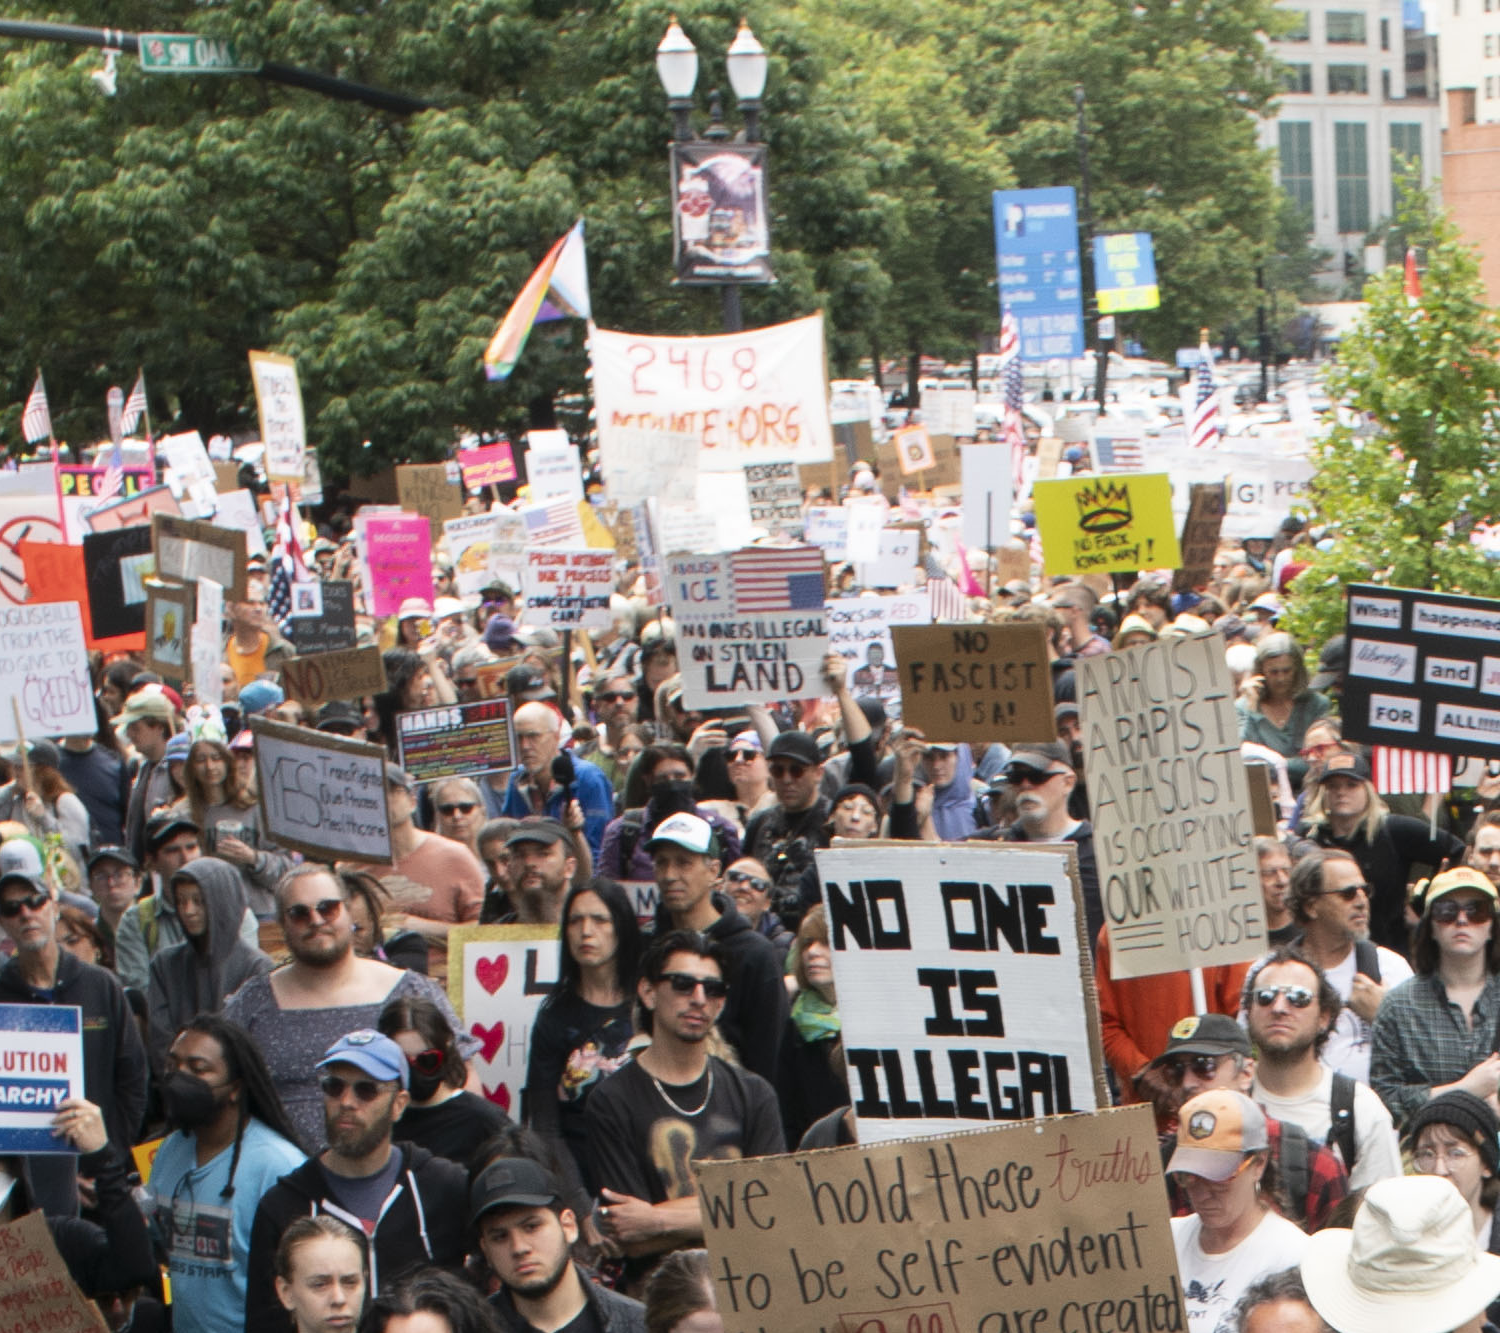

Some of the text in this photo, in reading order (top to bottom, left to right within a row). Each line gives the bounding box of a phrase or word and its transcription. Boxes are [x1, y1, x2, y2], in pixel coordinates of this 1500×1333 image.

[195, 39, 233, 67] OAK
[628, 345, 757, 394] 2468
[681, 579, 720, 601] ICE
[756, 618, 828, 638] ILLEGAL
[1351, 598, 1401, 626] What
[953, 632, 988, 653] NO
[706, 662, 804, 692] LAND
[911, 662, 1035, 690] FASCIST
[1084, 651, 1221, 700] A RACIST
[1430, 661, 1471, 684] and
[402, 711, 462, 729] HANDS
[950, 700, 1016, 725] USA!
[1090, 697, 1237, 755] A RAPIST
[1375, 705, 1414, 724] FOR
[1095, 749, 1240, 806] A FASCIST
[1105, 813, 1251, 865] IS OCCUPYING
[826, 880, 1061, 954] NO ONE
[1107, 878, 1154, 923] OUR
[1178, 911, 1262, 952] HOUSE
[918, 967, 1005, 1037] IS
[847, 1048, 1080, 1120] ILLEGAL
[700, 1134, 1160, 1231] we hold these truths
[719, 1212, 1149, 1311] to be self-evident
